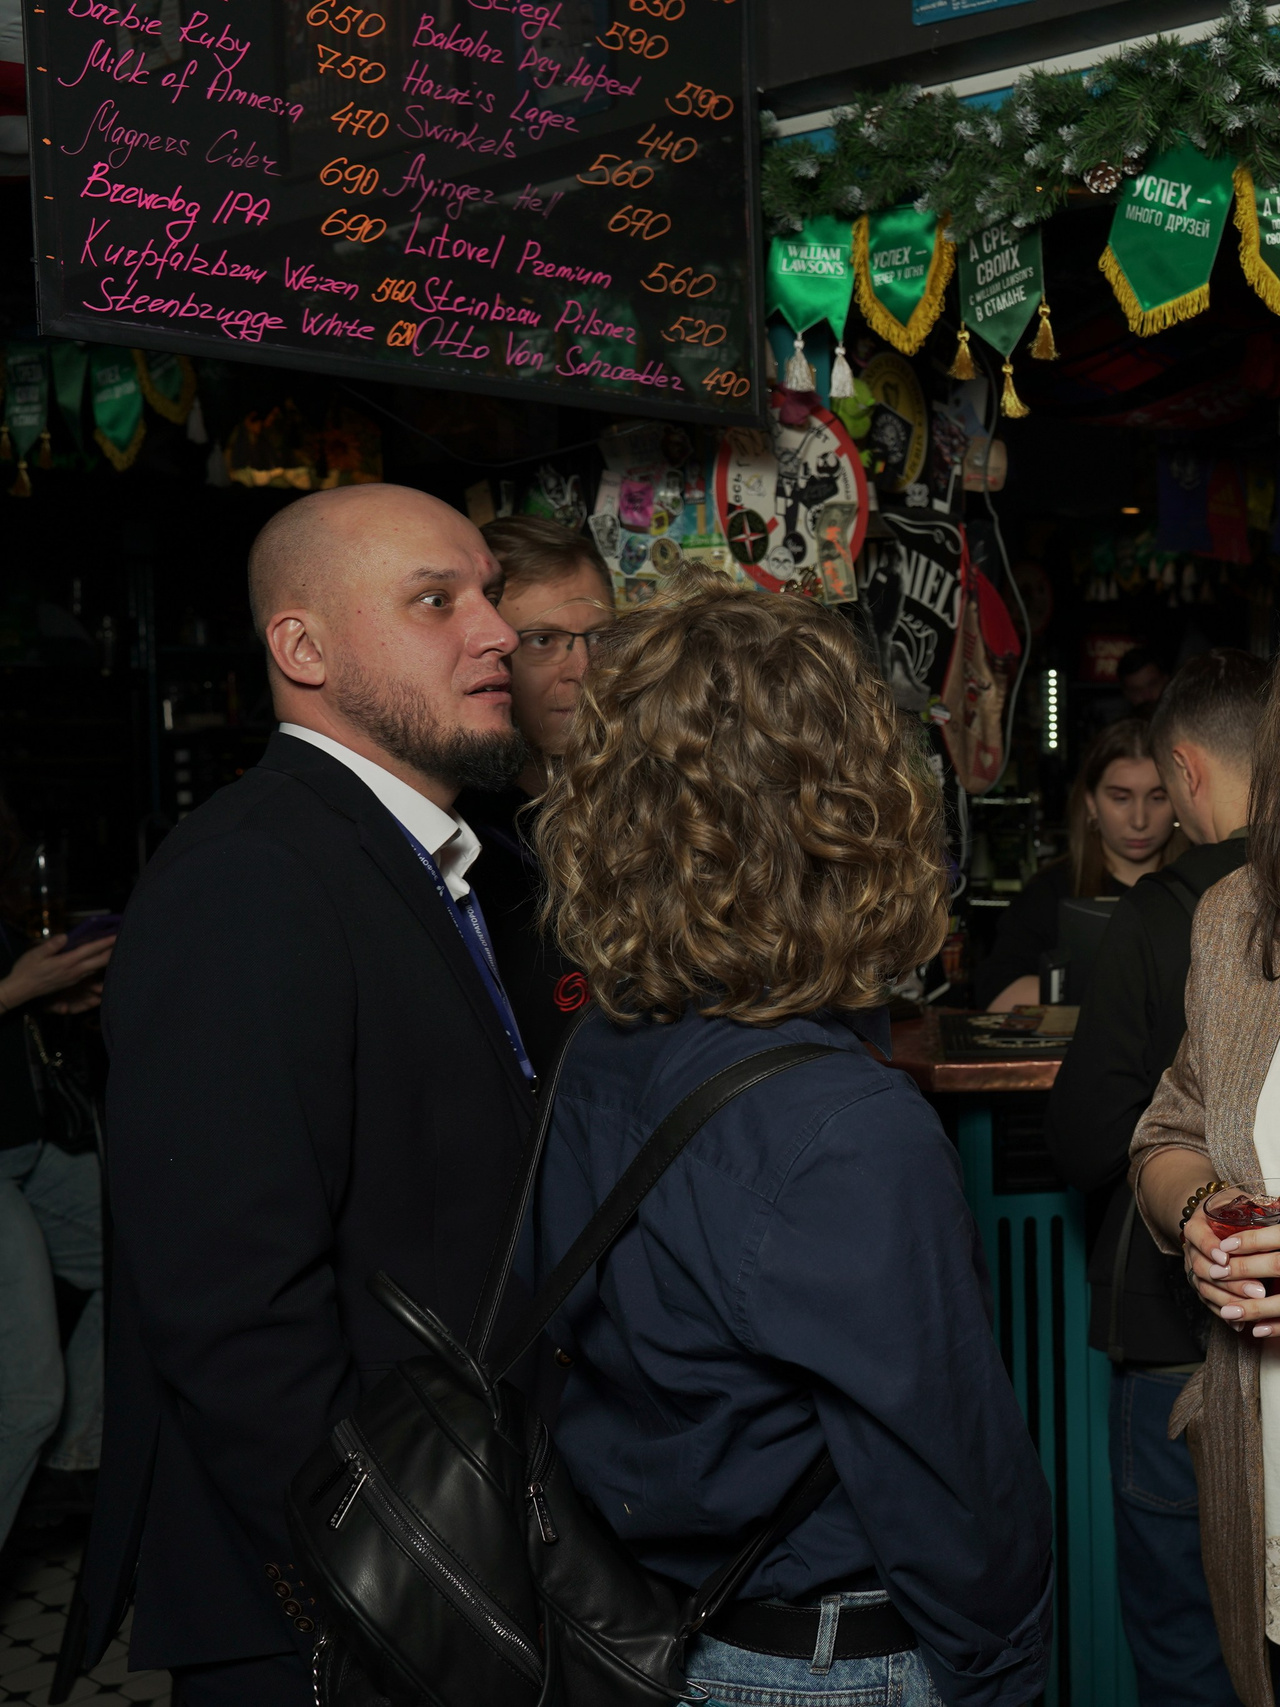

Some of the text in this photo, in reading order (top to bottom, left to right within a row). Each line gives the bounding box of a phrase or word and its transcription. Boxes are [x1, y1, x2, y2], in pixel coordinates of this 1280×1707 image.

[179, 11, 251, 70] Ruby
[317, 43, 387, 84] 750
[595, 21, 670, 59] 590
[58, 38, 390, 139] Milk of Amnesia 470
[565, 57, 642, 103] Hoped
[665, 81, 734, 121] 590
[60, 99, 380, 195] Magners Cider 690
[397, 104, 655, 189] Swinkels 560
[509, 90, 580, 140] Lager
[636, 123, 698, 163] 440
[80, 161, 387, 243] Brewdog IPA 690
[513, 183, 565, 217] Hell
[607, 204, 672, 241] 670
[1132, 174, 1193, 211] УСПЕХ
[1262, 197, 1272, 217] А
[1125, 204, 1211, 239] МНОГО ДРУЗЕЙ
[404, 212, 717, 298] Litovel Premium 560
[781, 258, 845, 276] LAWSON'S
[786, 245, 841, 261] WILLIAM
[872, 245, 912, 270] УСПЕХ
[969, 238, 979, 262] А
[976, 244, 1021, 286] СВОИХ
[284, 257, 360, 300] Weizen
[1002, 266, 1034, 290] LAWSON'S
[301, 308, 376, 341] White
[553, 300, 638, 345] Pilsner
[660, 315, 727, 347] 520
[975, 285, 1027, 322] В СТАКАНЕ
[411, 316, 491, 359] Otto
[505, 331, 544, 371] Von
[701, 367, 751, 398] 490
